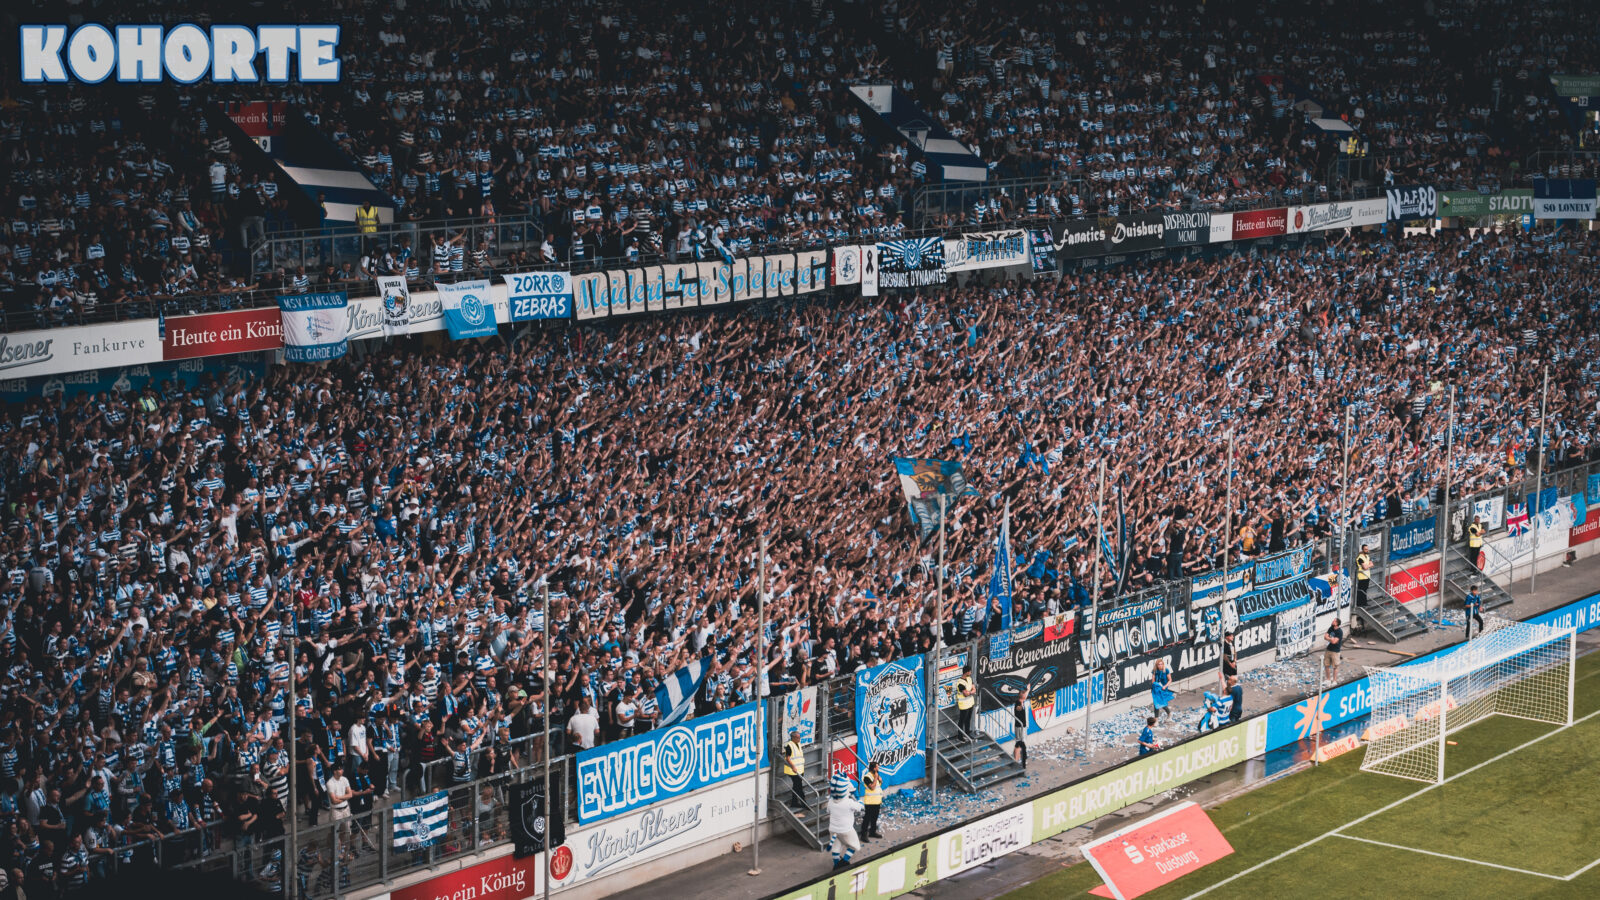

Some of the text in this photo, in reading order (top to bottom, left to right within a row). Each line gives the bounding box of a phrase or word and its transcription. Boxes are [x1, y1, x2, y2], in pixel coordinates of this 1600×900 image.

[261, 112, 286, 126] Knig
[1358, 207, 1385, 218] Fankurve
[1543, 203, 1592, 213] SO LONELY
[1164, 212, 1210, 230] DISPARGUM
[1212, 224, 1226, 233] urve
[1235, 215, 1285, 232] Heute ein König
[1053, 220, 1164, 251] Fanatics Duisburg
[879, 267, 947, 288] DUISBURG DYNAMITES
[283, 294, 343, 309] MSV FANCLUB
[514, 296, 566, 317] ZEBRAS
[346, 303, 385, 333] Köni
[73, 337, 146, 356] Fankurve
[172, 328, 217, 348] Heute
[220, 324, 242, 341] ein
[306, 346, 331, 359] GARDE
[1413, 527, 1435, 545] Duisburg
[1572, 518, 1598, 537] Heute ein
[1388, 570, 1439, 596] Heute ein König
[1236, 579, 1309, 616] WEDAUSTADION
[1576, 604, 1587, 628] IN
[979, 651, 1014, 675] Proud
[1015, 638, 1071, 668] Generation
[1124, 655, 1174, 689] IMMR
[1178, 643, 1221, 671] ALLES
[1234, 622, 1272, 652] EBEN!
[578, 707, 764, 820] EWIG TREU
[1042, 736, 1240, 831] IHR BÜROPROFI AUS DUISBURG
[585, 794, 762, 869] König Pilsener Fankurv
[964, 832, 1019, 864] LILIENTHAL
[1143, 831, 1191, 859] Sparkasse
[1155, 849, 1200, 875] Duisburg
[453, 867, 526, 900] ein König
